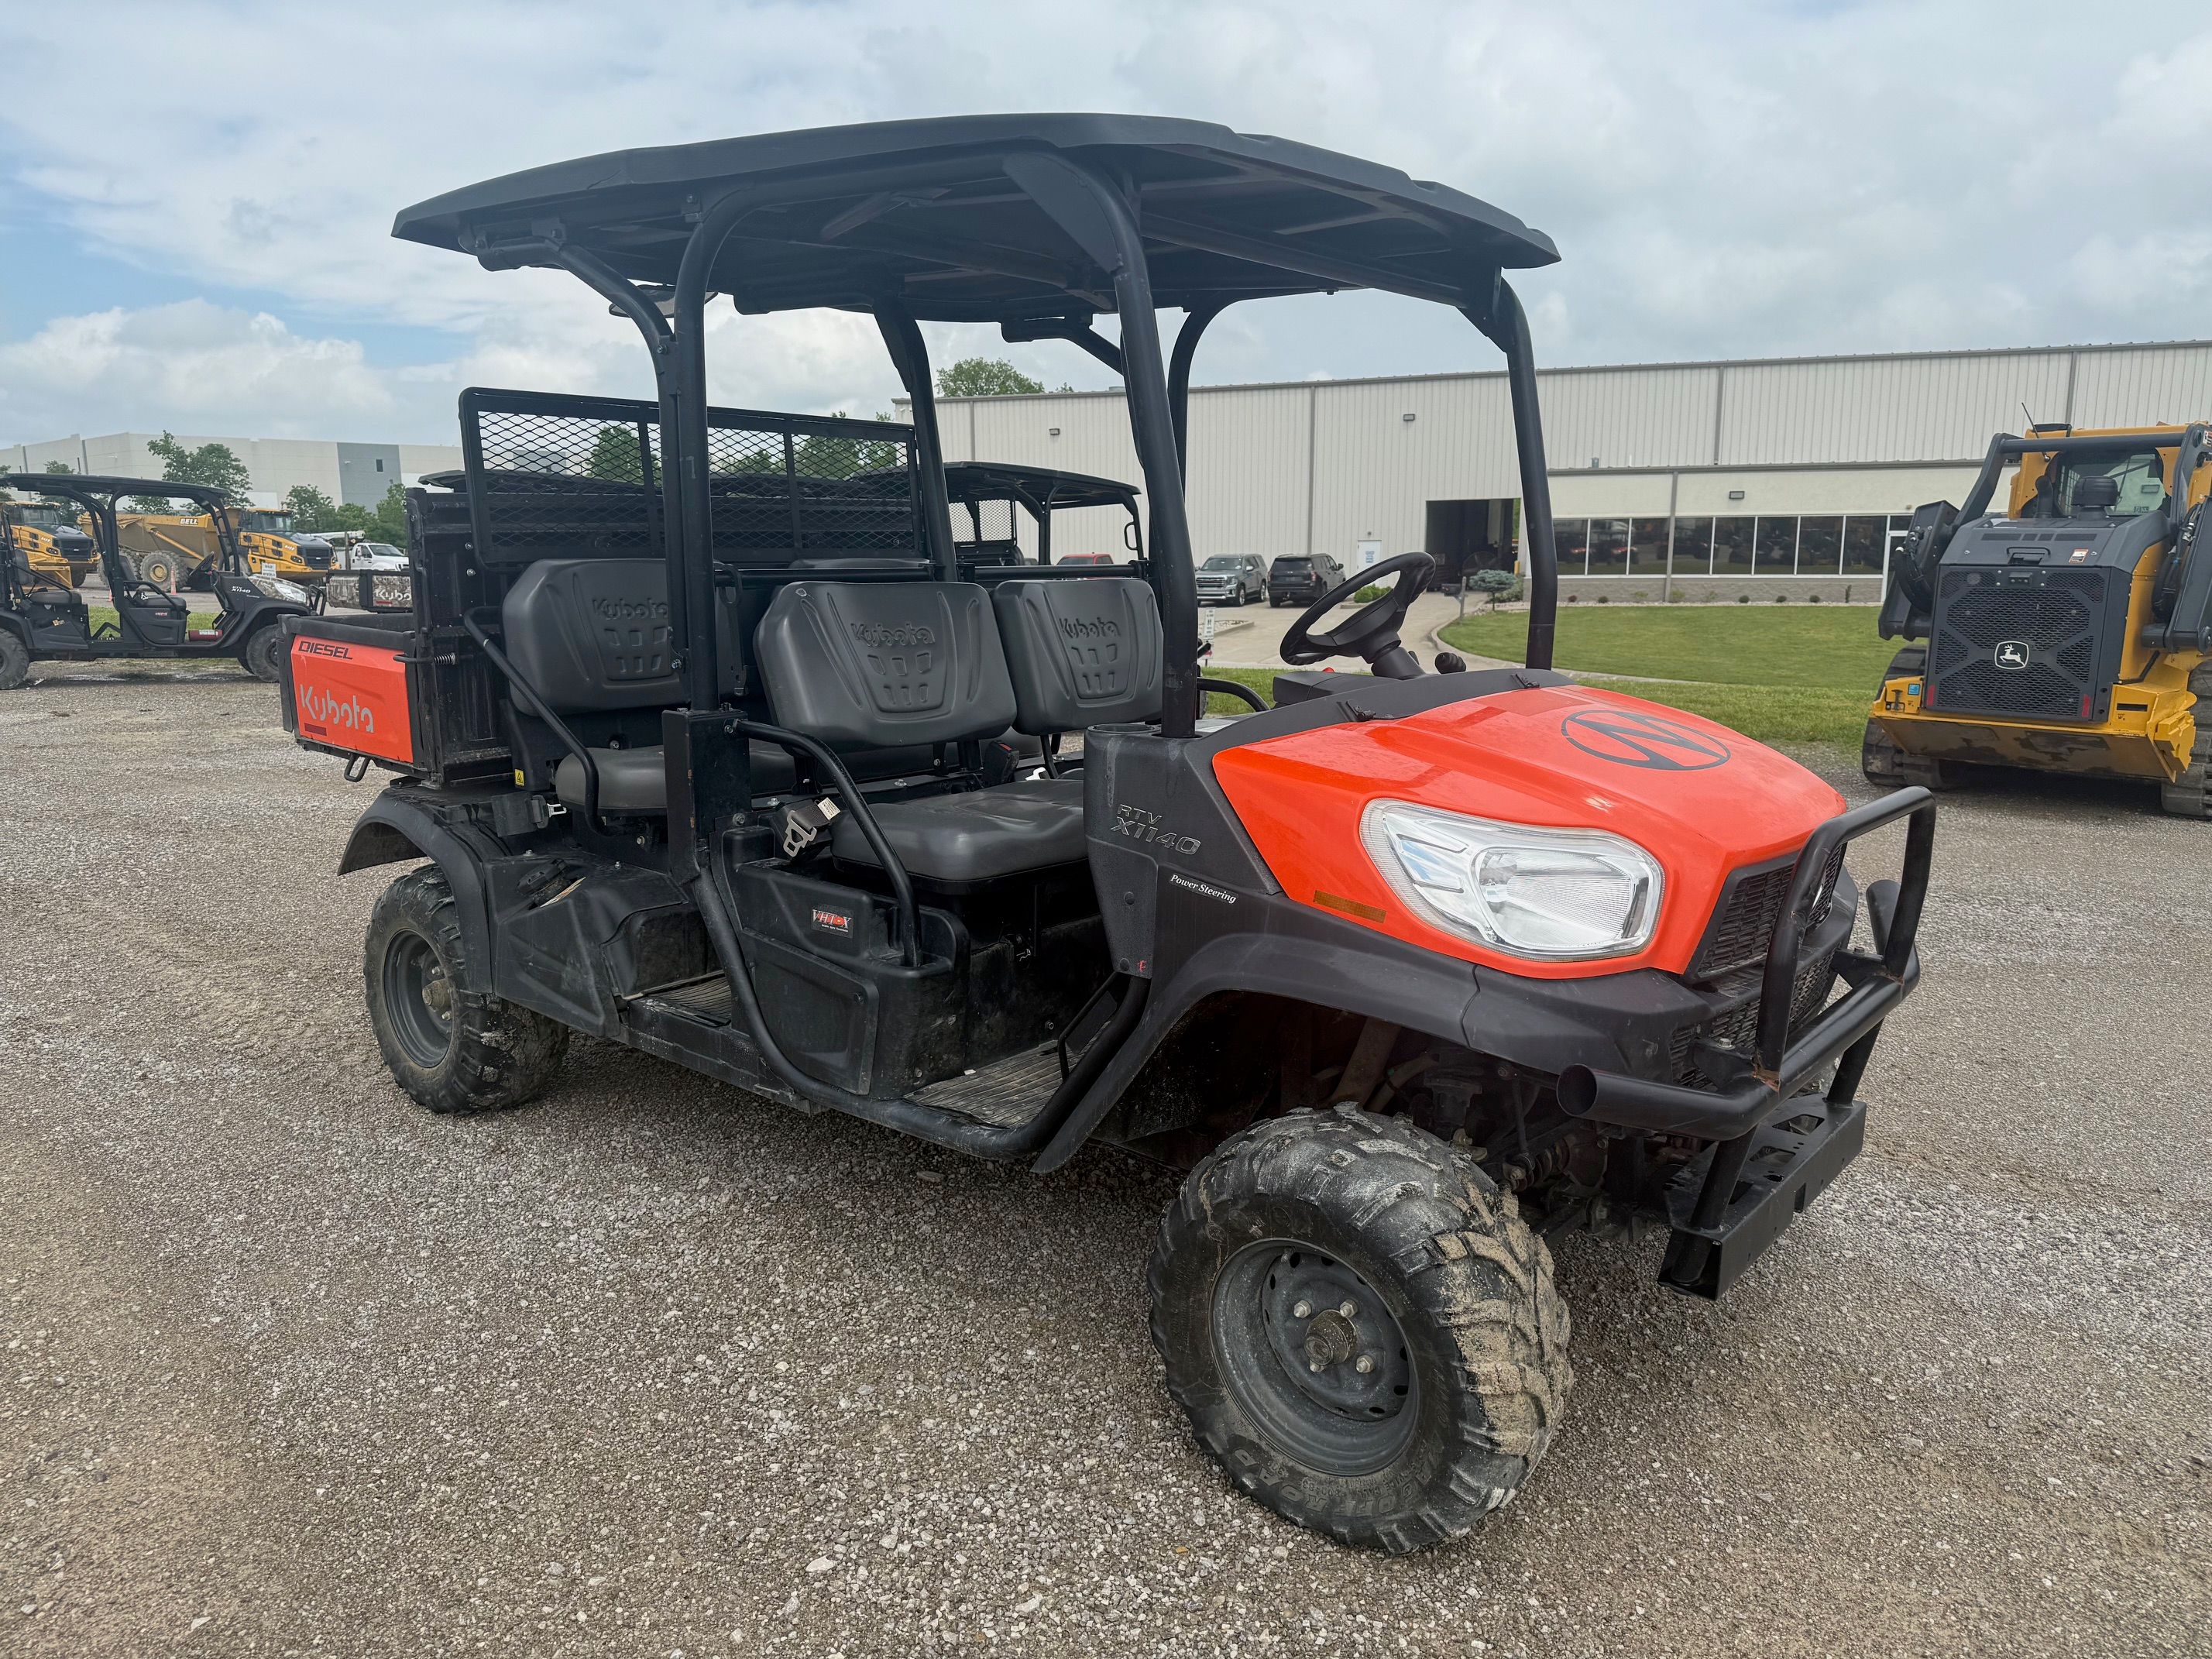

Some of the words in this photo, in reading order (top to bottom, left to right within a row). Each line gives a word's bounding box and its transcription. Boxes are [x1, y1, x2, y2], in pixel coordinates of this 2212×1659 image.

[850, 623, 936, 647] Kubota
[1059, 617, 1121, 639] Kubota
[298, 641, 353, 660] DIESEL
[300, 684, 374, 733] Kubota
[1118, 804, 1162, 825] RTV
[1110, 816, 1201, 855] X1140
[1170, 874, 1199, 889] Power
[1198, 884, 1237, 905] Steering
